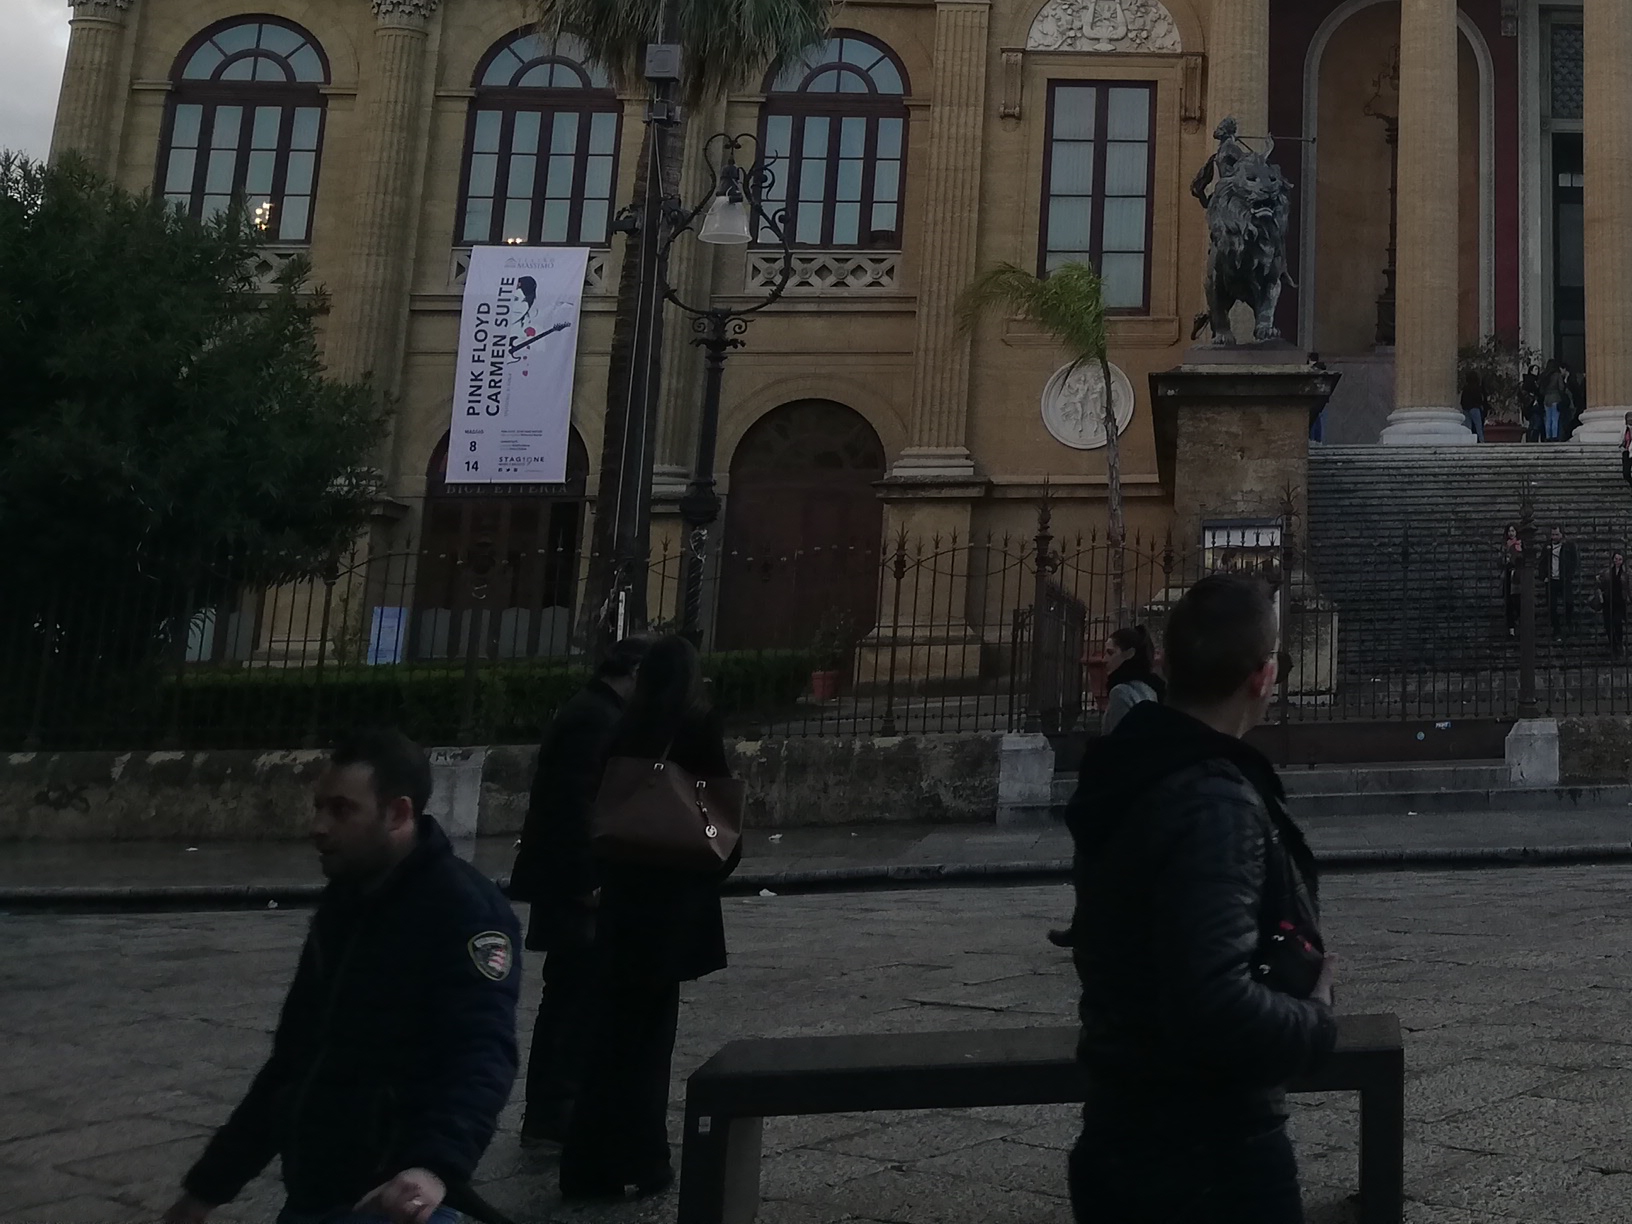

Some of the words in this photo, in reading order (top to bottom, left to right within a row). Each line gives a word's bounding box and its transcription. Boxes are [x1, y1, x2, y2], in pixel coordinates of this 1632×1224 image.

[496, 276, 516, 328] SUITE
[471, 302, 491, 363] FLOYD
[466, 370, 485, 417] PINK
[485, 334, 508, 417] CARMEN
[464, 460, 480, 472] 14
[469, 440, 477, 452] 8
